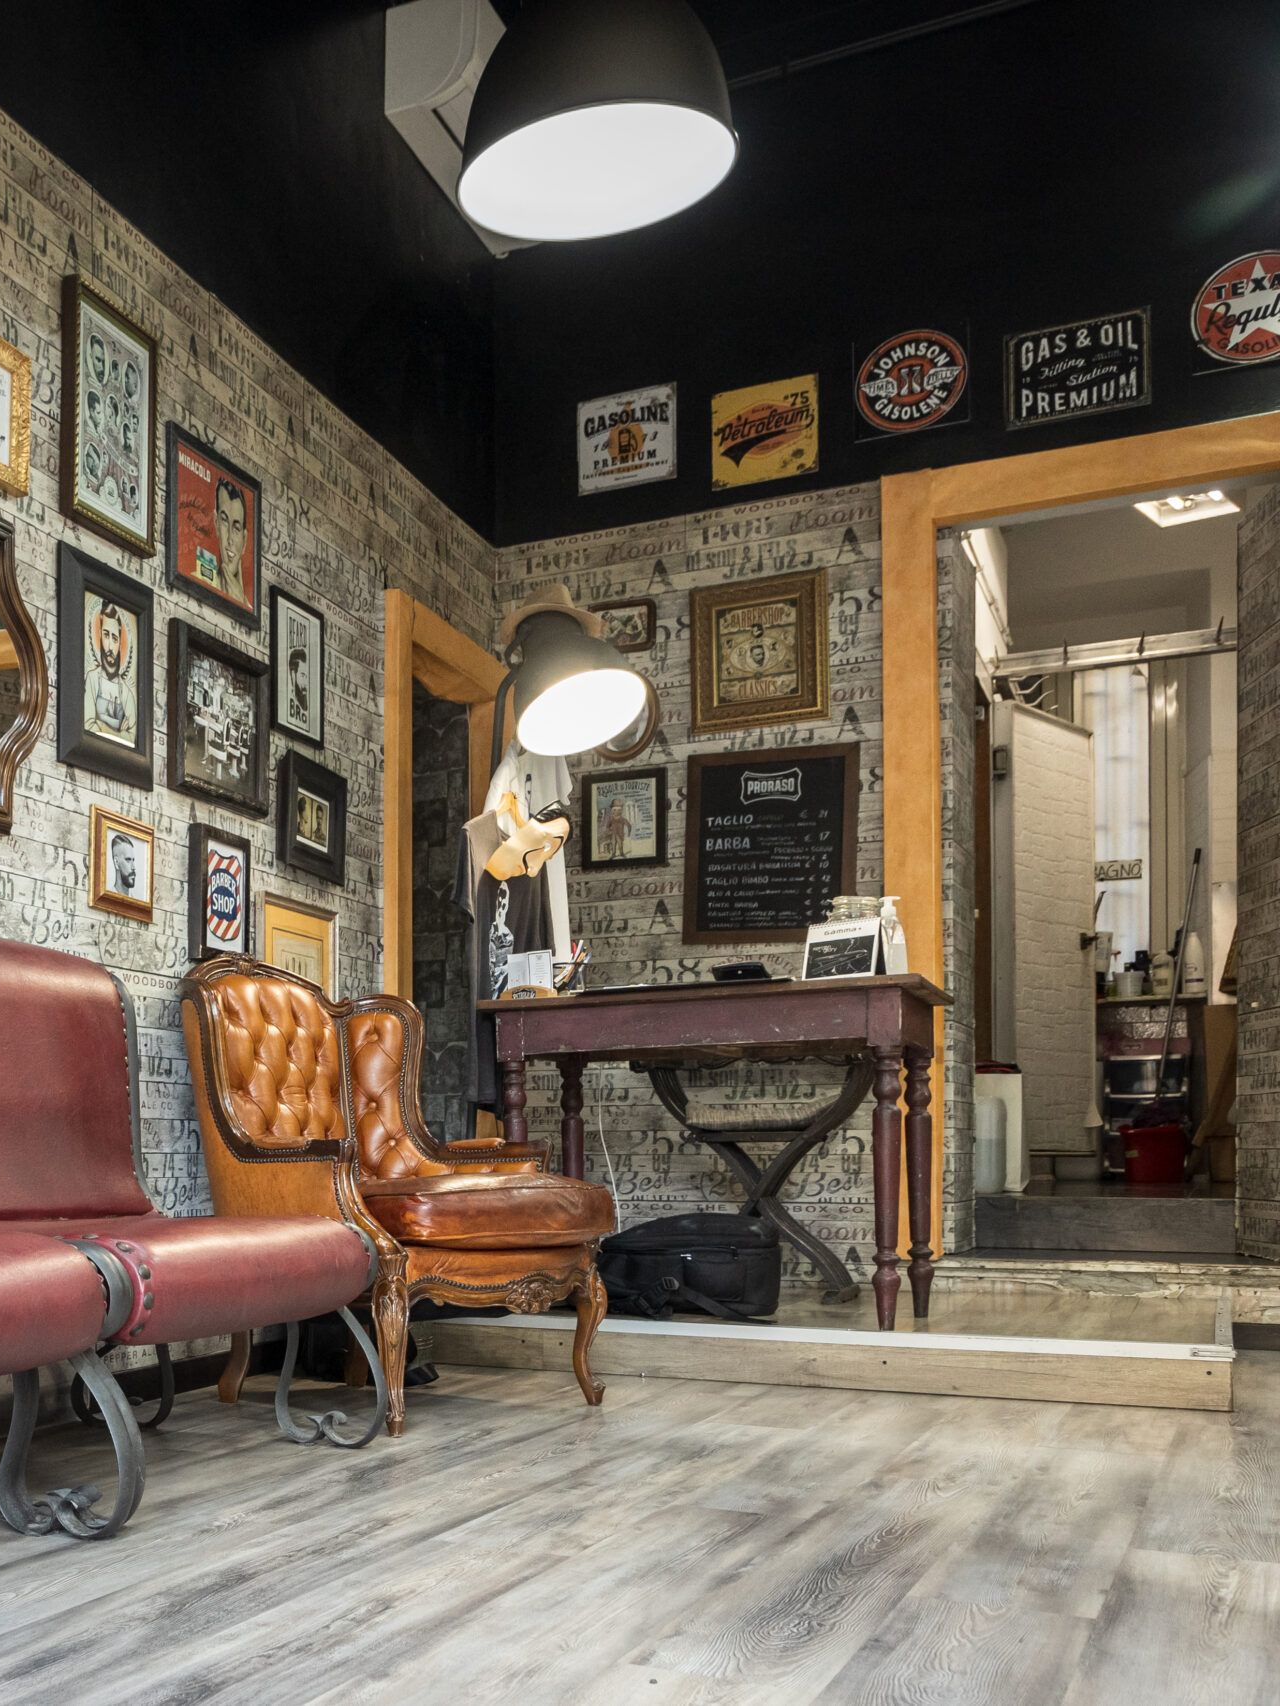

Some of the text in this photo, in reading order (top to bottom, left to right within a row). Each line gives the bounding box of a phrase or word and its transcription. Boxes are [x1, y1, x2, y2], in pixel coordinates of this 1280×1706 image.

[1020, 333, 1068, 372] GAS
[1075, 328, 1092, 348] &
[1100, 320, 1139, 351] OIL
[873, 342, 951, 378] JOHNSON
[1038, 357, 1087, 380] Filling
[1066, 364, 1119, 387] Station
[1020, 366, 1138, 418] PREMIUM
[874, 388, 948, 420] GASOLENE
[584, 402, 670, 438] GASOLINE
[718, 404, 815, 447] Petroleum
[179, 451, 211, 483] MIRACOLO
[593, 449, 657, 470] PREMIUM
[733, 493, 826, 515] WOODBOX
[554, 526, 638, 546] WOODBOX
[289, 617, 307, 650] BEARD
[747, 778, 795, 795] PRORASO
[705, 814, 754, 828] TAGLIO
[705, 836, 751, 851] BARBA
[211, 870, 237, 898] BARBER
[705, 876, 738, 886] TAGLIO
[212, 893, 235, 915] SHOP
[695, 1204, 727, 1212] THE
